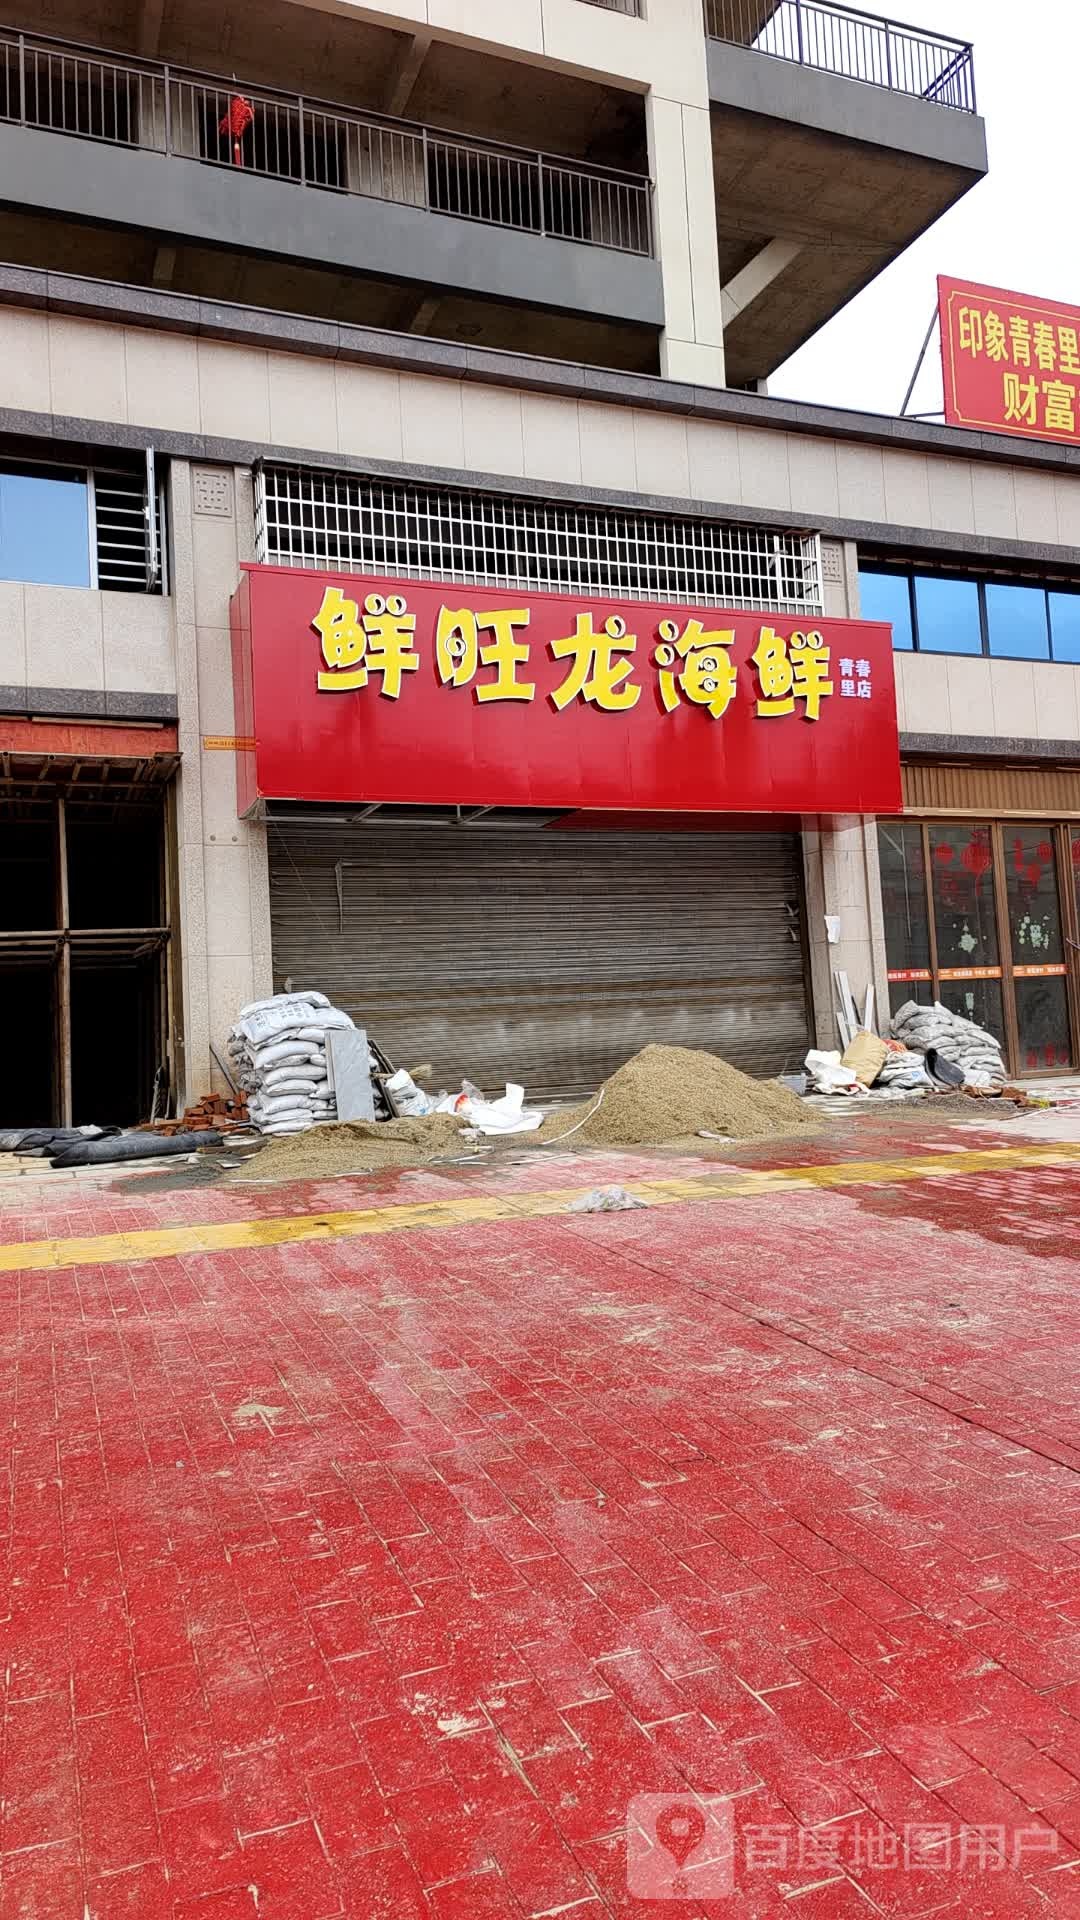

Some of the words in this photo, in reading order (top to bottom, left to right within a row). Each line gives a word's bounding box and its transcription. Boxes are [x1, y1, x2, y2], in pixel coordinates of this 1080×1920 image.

[958, 306, 1080, 376] 印象青春里
[1003, 372, 1076, 432] 财富
[312, 586, 834, 721] 鲜旺龙海鲜
[838, 658, 872, 678] 青春
[840, 680, 872, 698] 里店
